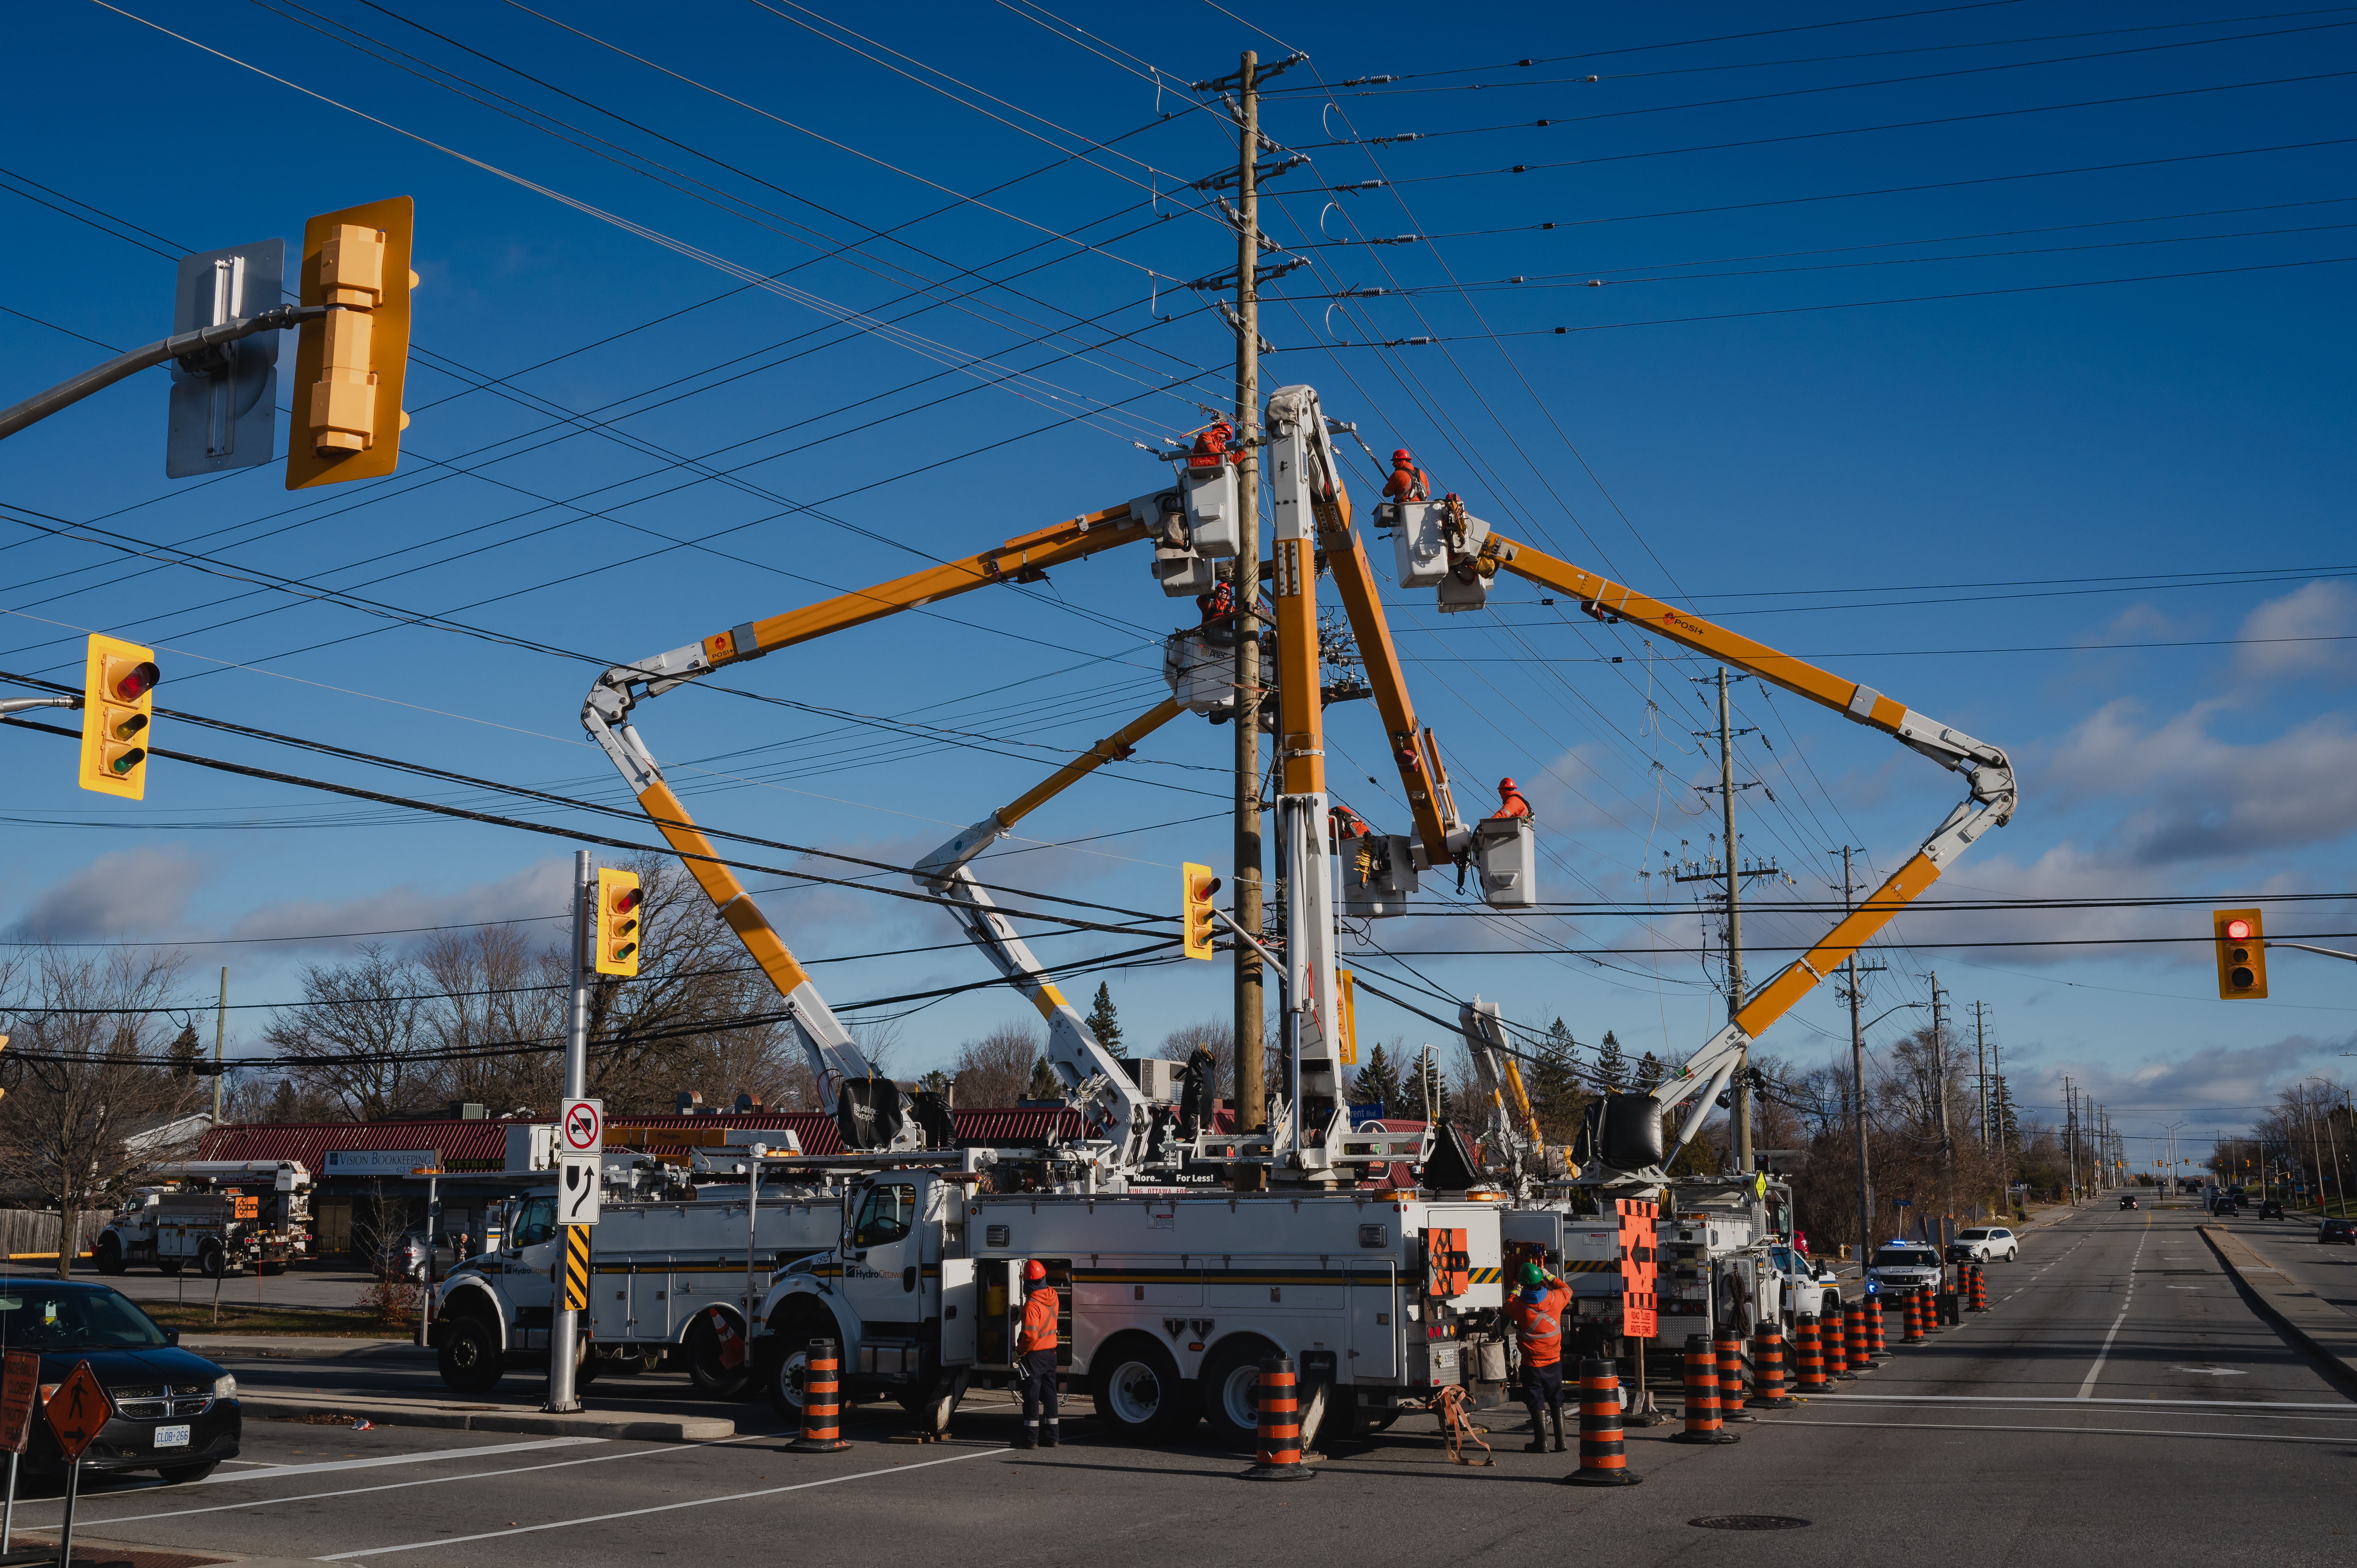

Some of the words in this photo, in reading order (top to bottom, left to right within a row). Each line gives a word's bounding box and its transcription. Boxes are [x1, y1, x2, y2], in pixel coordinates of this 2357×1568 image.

[1674, 619, 1704, 635] POSI+
[712, 648, 734, 659] POSI+
[1209, 650, 1228, 659] Altec
[861, 1105, 879, 1115] Altec
[1351, 1109, 1364, 1118] rent
[854, 1109, 878, 1122] Supply
[340, 1153, 376, 1165] VISION
[380, 1152, 431, 1165] BOOKKEEPING
[512, 1267, 551, 1275] HydroOttawa
[856, 1270, 903, 1280] HydroOttawa
[1631, 1311, 1640, 1319] ROAD
[1641, 1312, 1650, 1320] CLOSED
[1631, 1325, 1641, 1333] ROUTE
[7, 1360, 36, 1378] SIDEWALK
[8, 1380, 31, 1397] CLOSED
[157, 1432, 173, 1442] CLDB
[176, 1430, 188, 1441] 266
